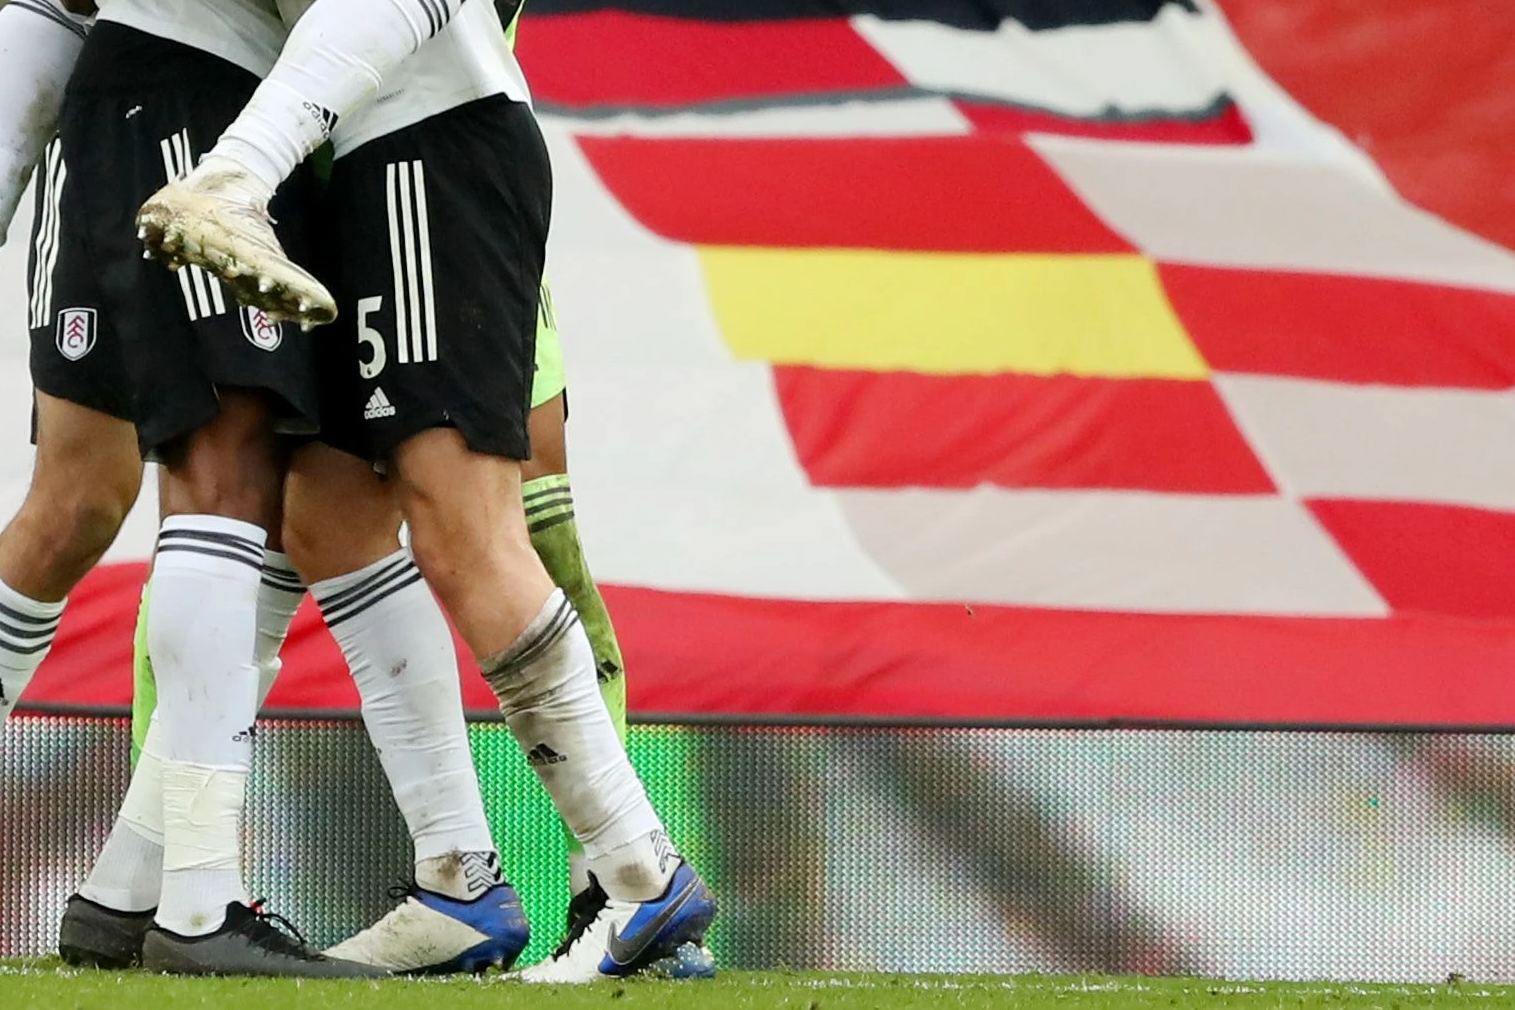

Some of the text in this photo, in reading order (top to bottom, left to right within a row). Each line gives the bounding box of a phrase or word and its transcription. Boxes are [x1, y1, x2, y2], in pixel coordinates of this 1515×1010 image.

[302, 100, 330, 139] adida
[357, 295, 387, 379] 5
[363, 405, 396, 420] adidas
